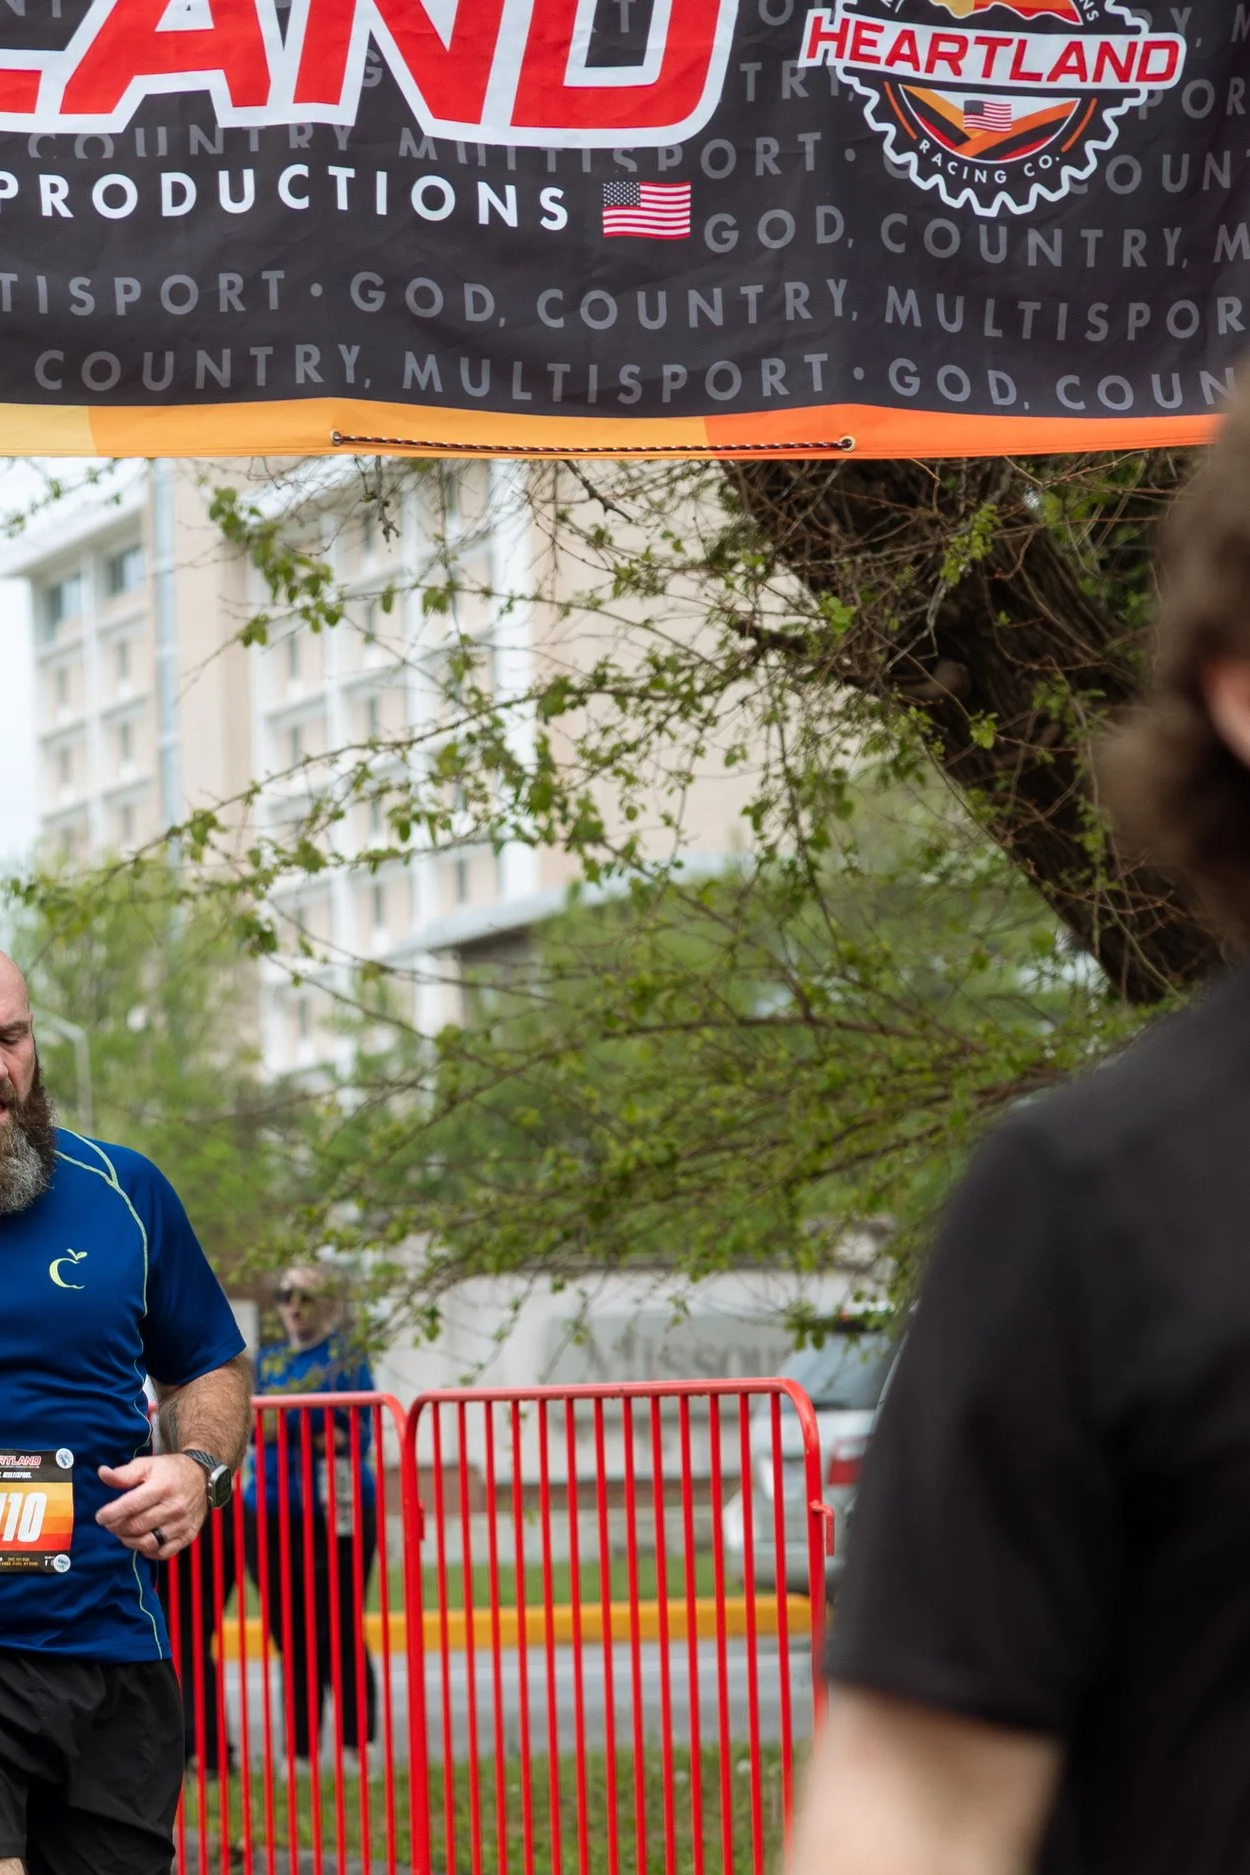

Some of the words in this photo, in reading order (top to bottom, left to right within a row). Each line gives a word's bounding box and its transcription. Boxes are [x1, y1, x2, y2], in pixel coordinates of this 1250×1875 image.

[804, 15, 1182, 83] HEARTLAND
[918, 138, 1008, 185] RACING
[1023, 153, 1061, 178] CO.
[703, 204, 855, 255] GOD,
[879, 212, 1189, 270] COUNTRY,
[349, 270, 507, 328] GOD,
[535, 278, 859, 331] COUNTRY,
[33, 343, 373, 393] COUNTRY,
[401, 350, 830, 405] MULTISPORT
[888, 356, 1032, 412] GOD,
